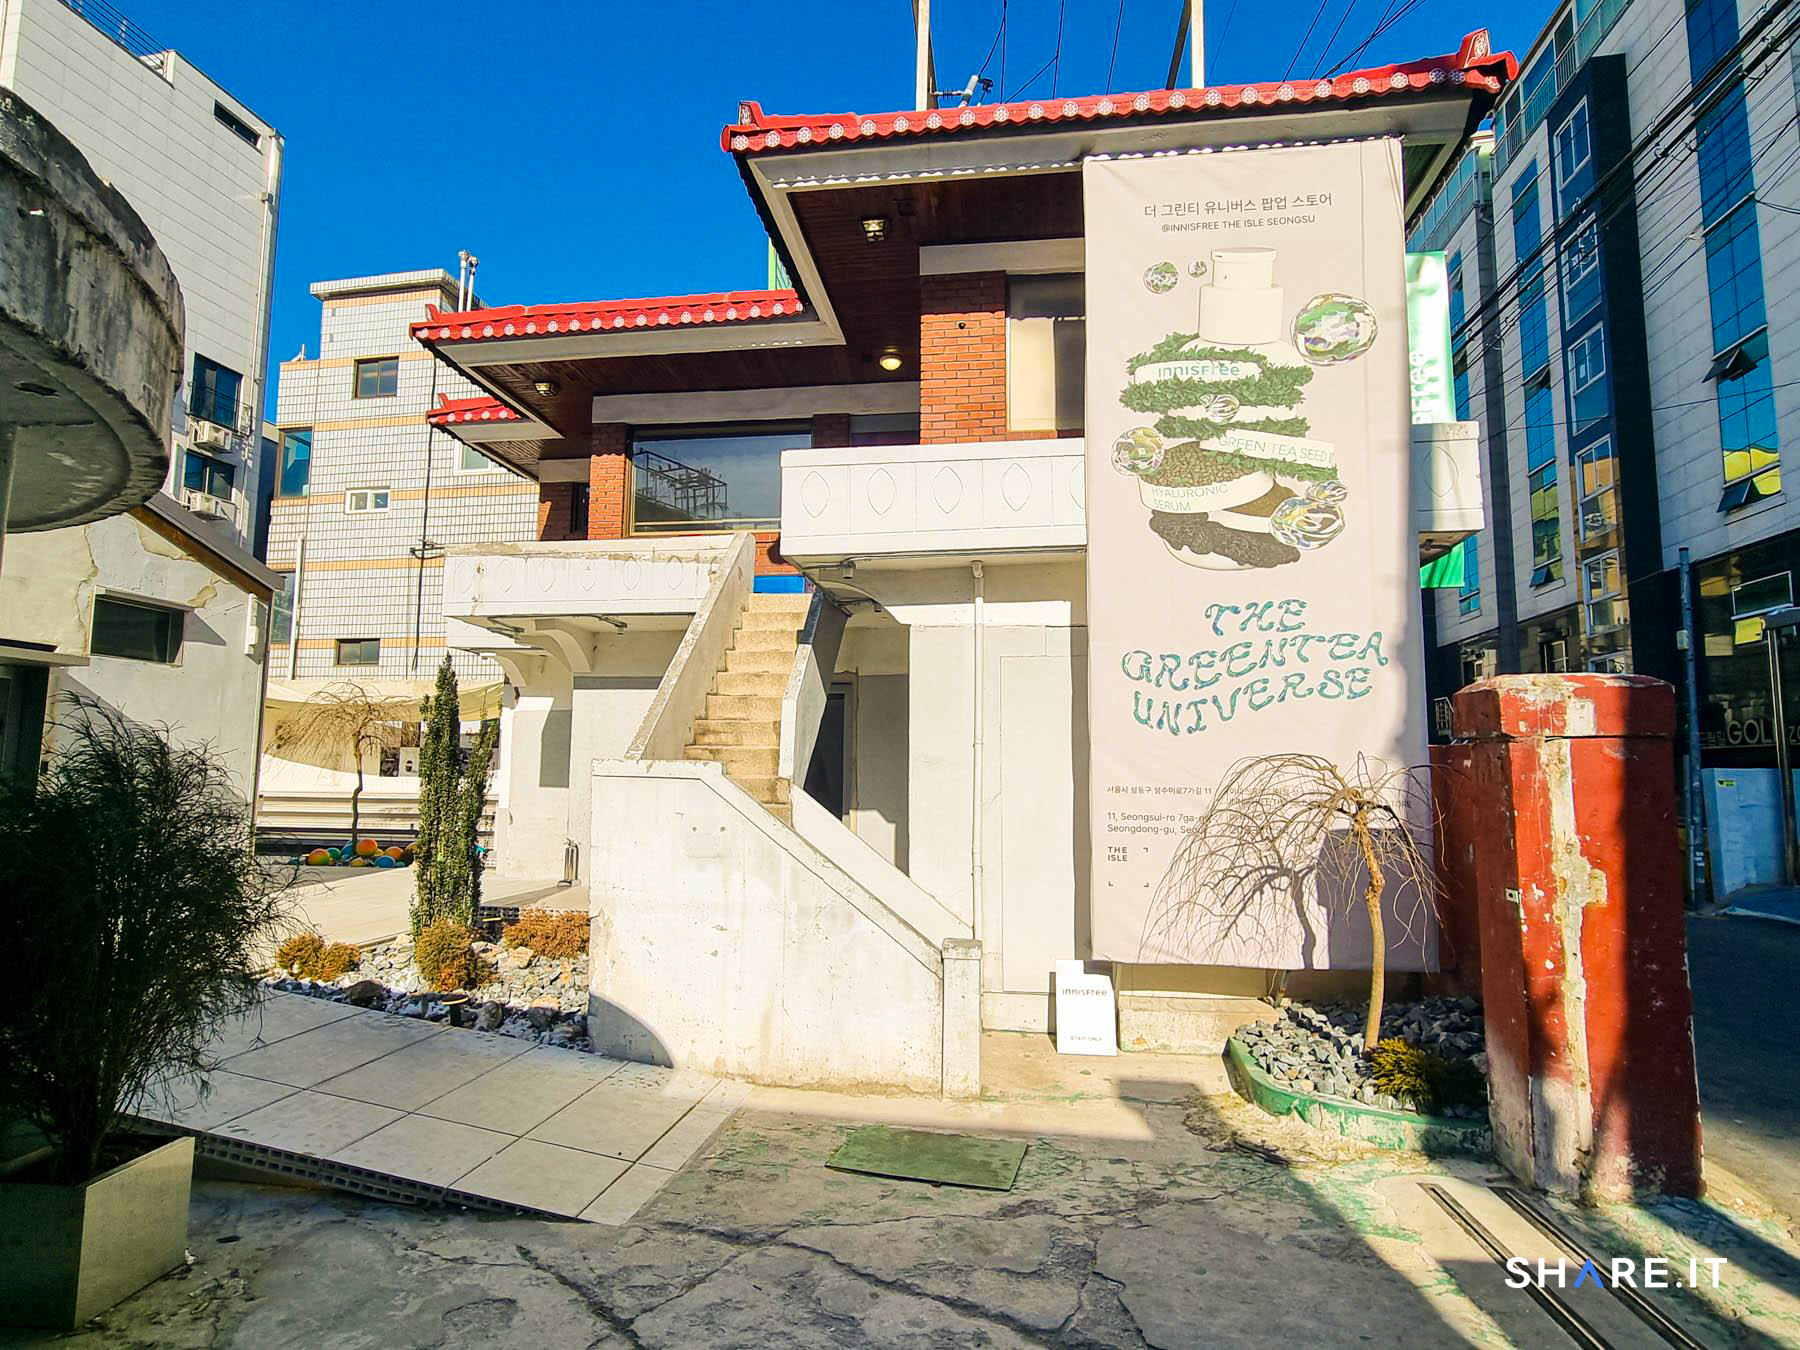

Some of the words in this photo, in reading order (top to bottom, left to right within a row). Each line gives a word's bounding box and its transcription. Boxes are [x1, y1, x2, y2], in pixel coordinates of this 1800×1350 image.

[1144, 205, 1157, 218] 더
[1160, 201, 1200, 217] 그린티
[1204, 199, 1257, 214] 유니버스
[1260, 196, 1287, 211] 팝업
[1291, 192, 1333, 208] 스토어
[1161, 221, 1220, 233] @INNISFREE
[1222, 219, 1241, 229] THE
[1243, 218, 1265, 227] ISLE
[1266, 215, 1316, 226] SEONGSU
[1218, 436, 1267, 453] GREEN
[1271, 443, 1298, 457] TEA
[1299, 447, 1327, 462] SEED
[1151, 484, 1229, 498] HYALURONIC
[1153, 499, 1192, 512] SERUM
[1204, 598, 1308, 636] THE
[1132, 667, 1373, 736] UNIVERSE
[1106, 785, 1128, 794] 서울시
[1130, 786, 1152, 795] 성동구
[1107, 812, 1118, 822] 11,
[1120, 812, 1175, 822] Seongsui-ro
[1107, 824, 1177, 835] Seongdong-gu,
[1107, 846, 1128, 854] THE
[1107, 854, 1128, 862] ISLE
